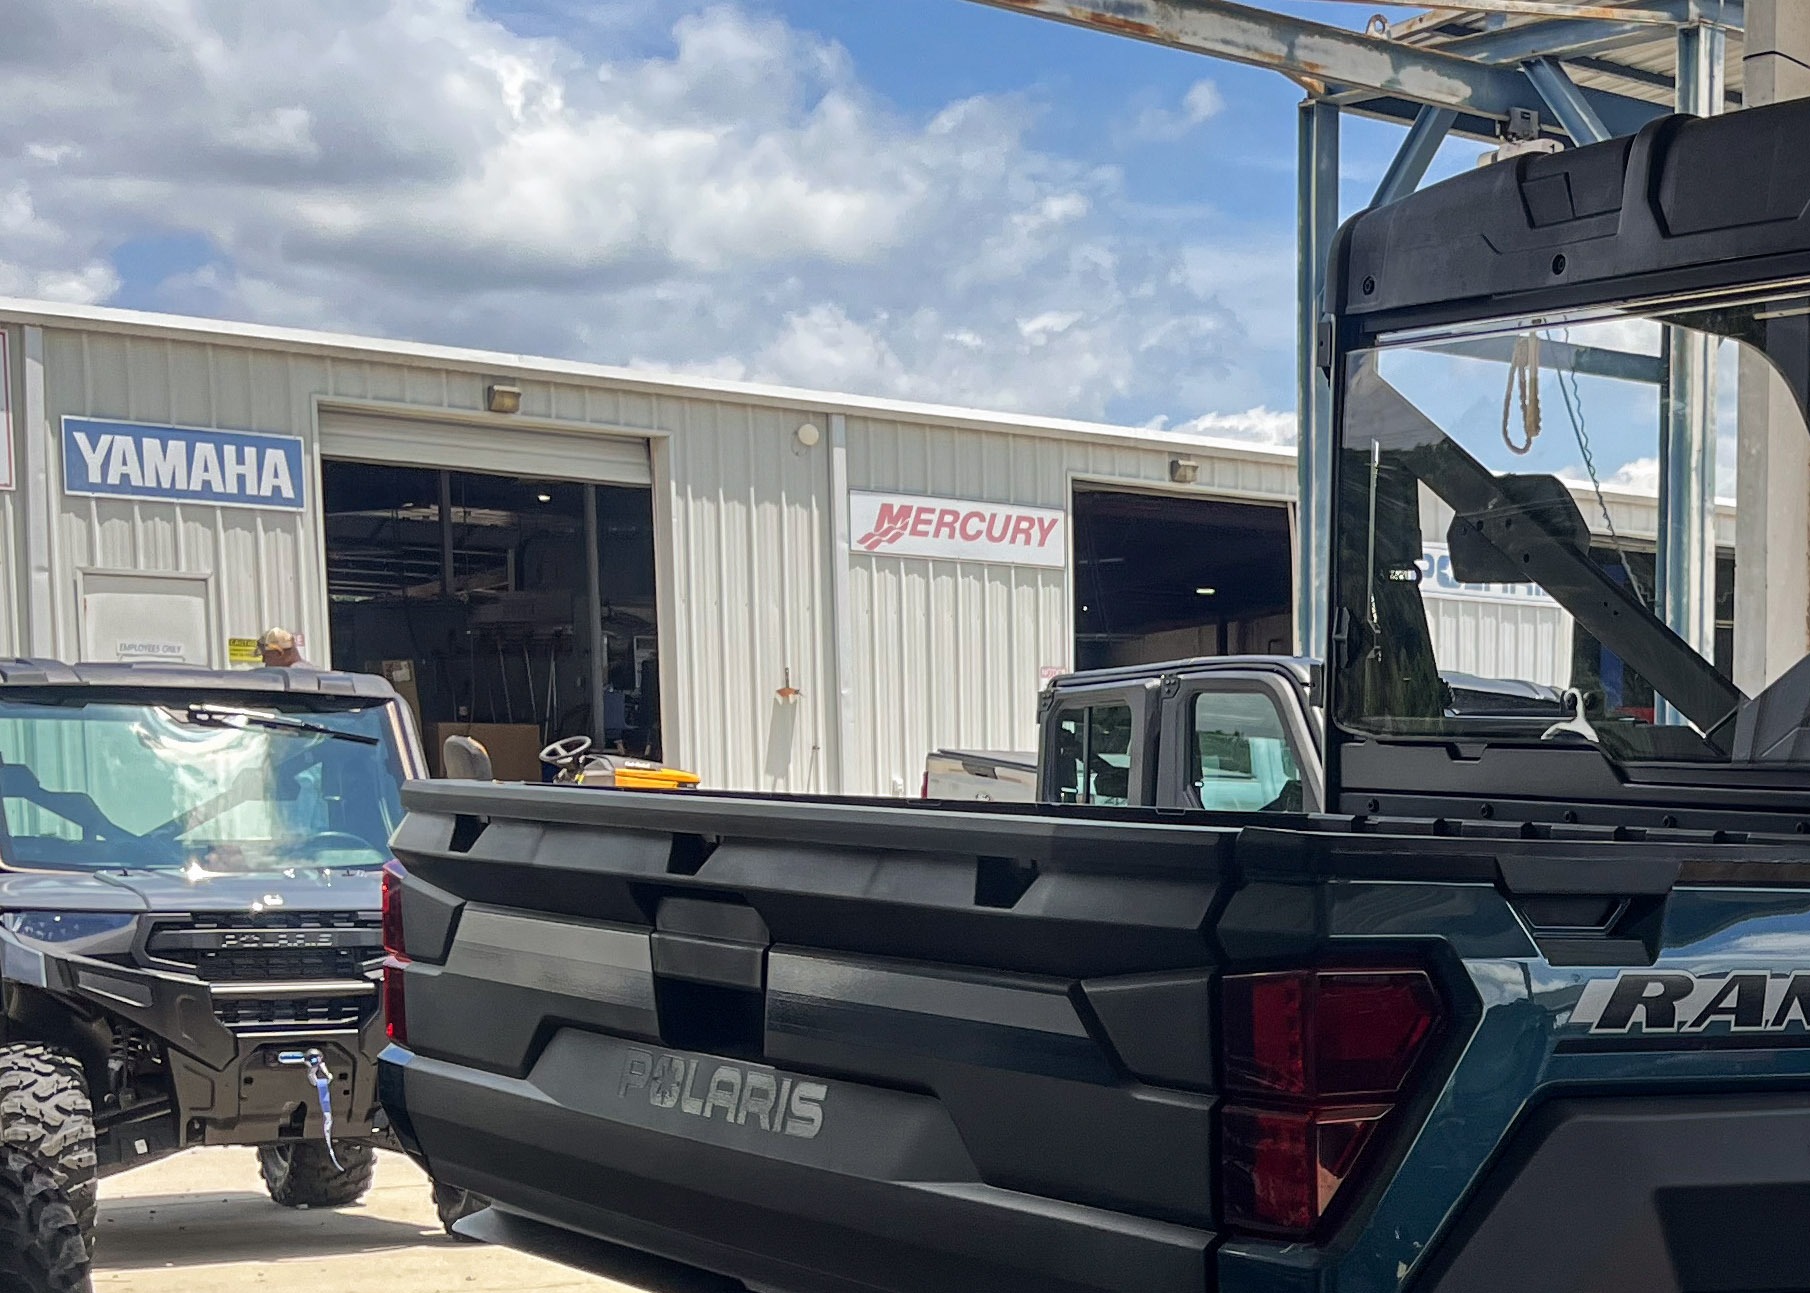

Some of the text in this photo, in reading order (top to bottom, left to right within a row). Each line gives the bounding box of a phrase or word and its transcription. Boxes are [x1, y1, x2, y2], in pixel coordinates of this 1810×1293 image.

[73, 431, 295, 498] YAMAHA
[857, 503, 1058, 550] MERCURY
[119, 642, 182, 654] EMPLOYEES ONLY
[221, 934, 333, 947] POLARIS
[619, 1048, 829, 1139] POLARIS
